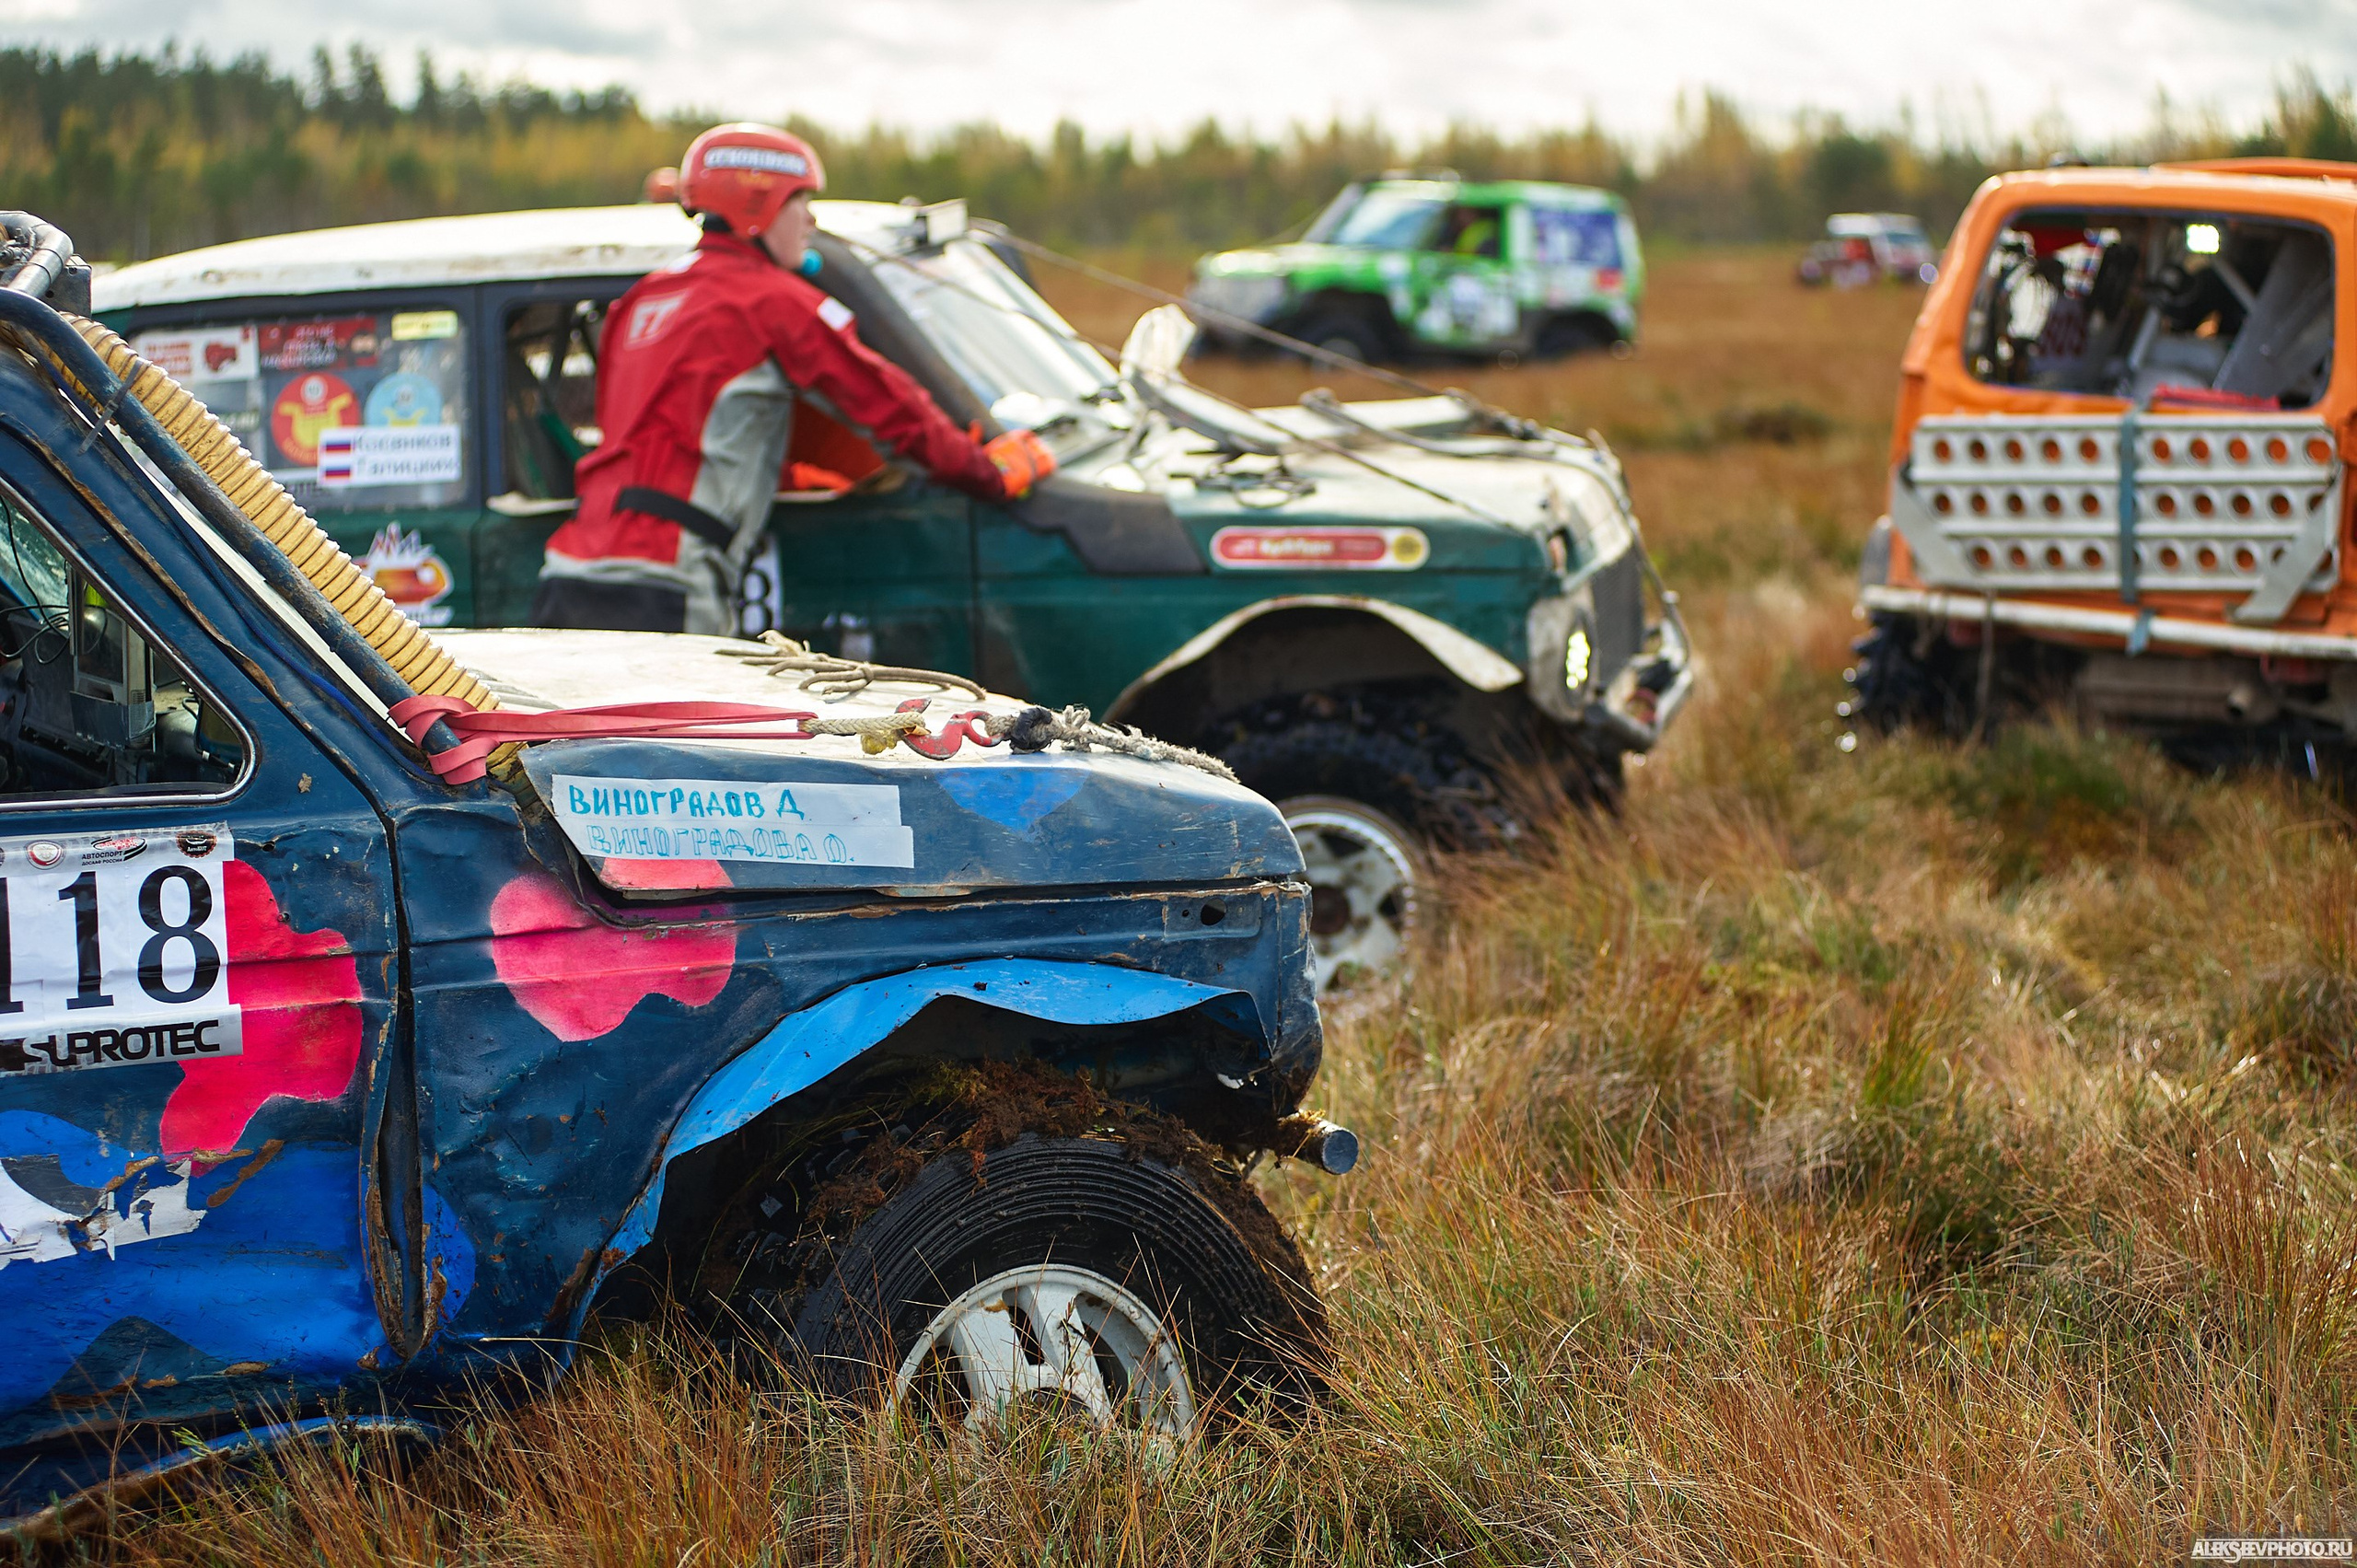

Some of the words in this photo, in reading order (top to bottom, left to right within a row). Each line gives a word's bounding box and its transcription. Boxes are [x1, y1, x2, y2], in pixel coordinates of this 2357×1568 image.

[568, 784, 765, 819] ВИНОГРАДОВ
[81, 850, 123, 860] АВТОСПОРТ
[586, 824, 817, 861] ВИНОГРАДОВА
[23, 1019, 221, 1066] SUPROTEC
